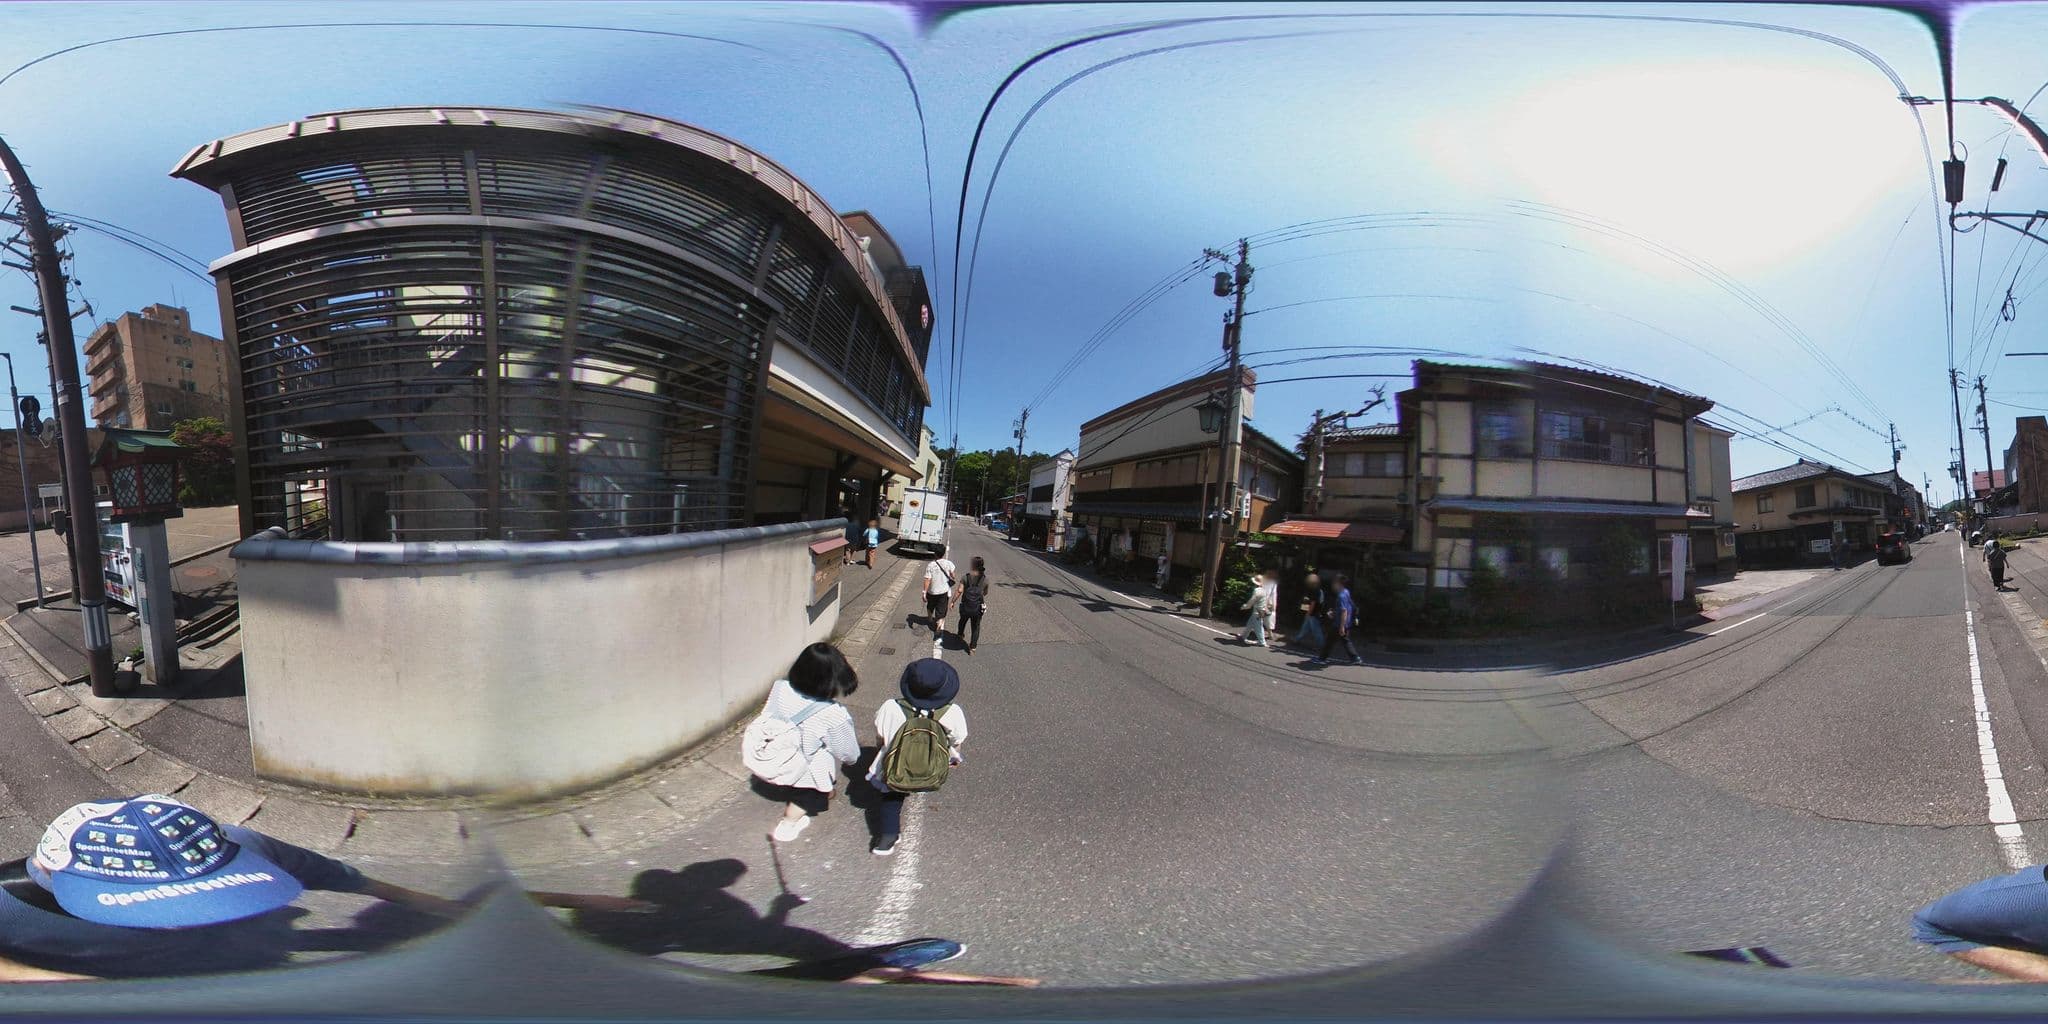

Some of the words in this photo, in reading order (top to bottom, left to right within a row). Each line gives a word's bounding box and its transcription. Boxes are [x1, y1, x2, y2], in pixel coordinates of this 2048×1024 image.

[75, 842, 152, 857] OpenStreetMap
[74, 861, 171, 879] OpenStreetMap
[96, 872, 275, 906] OpenStreetMap
